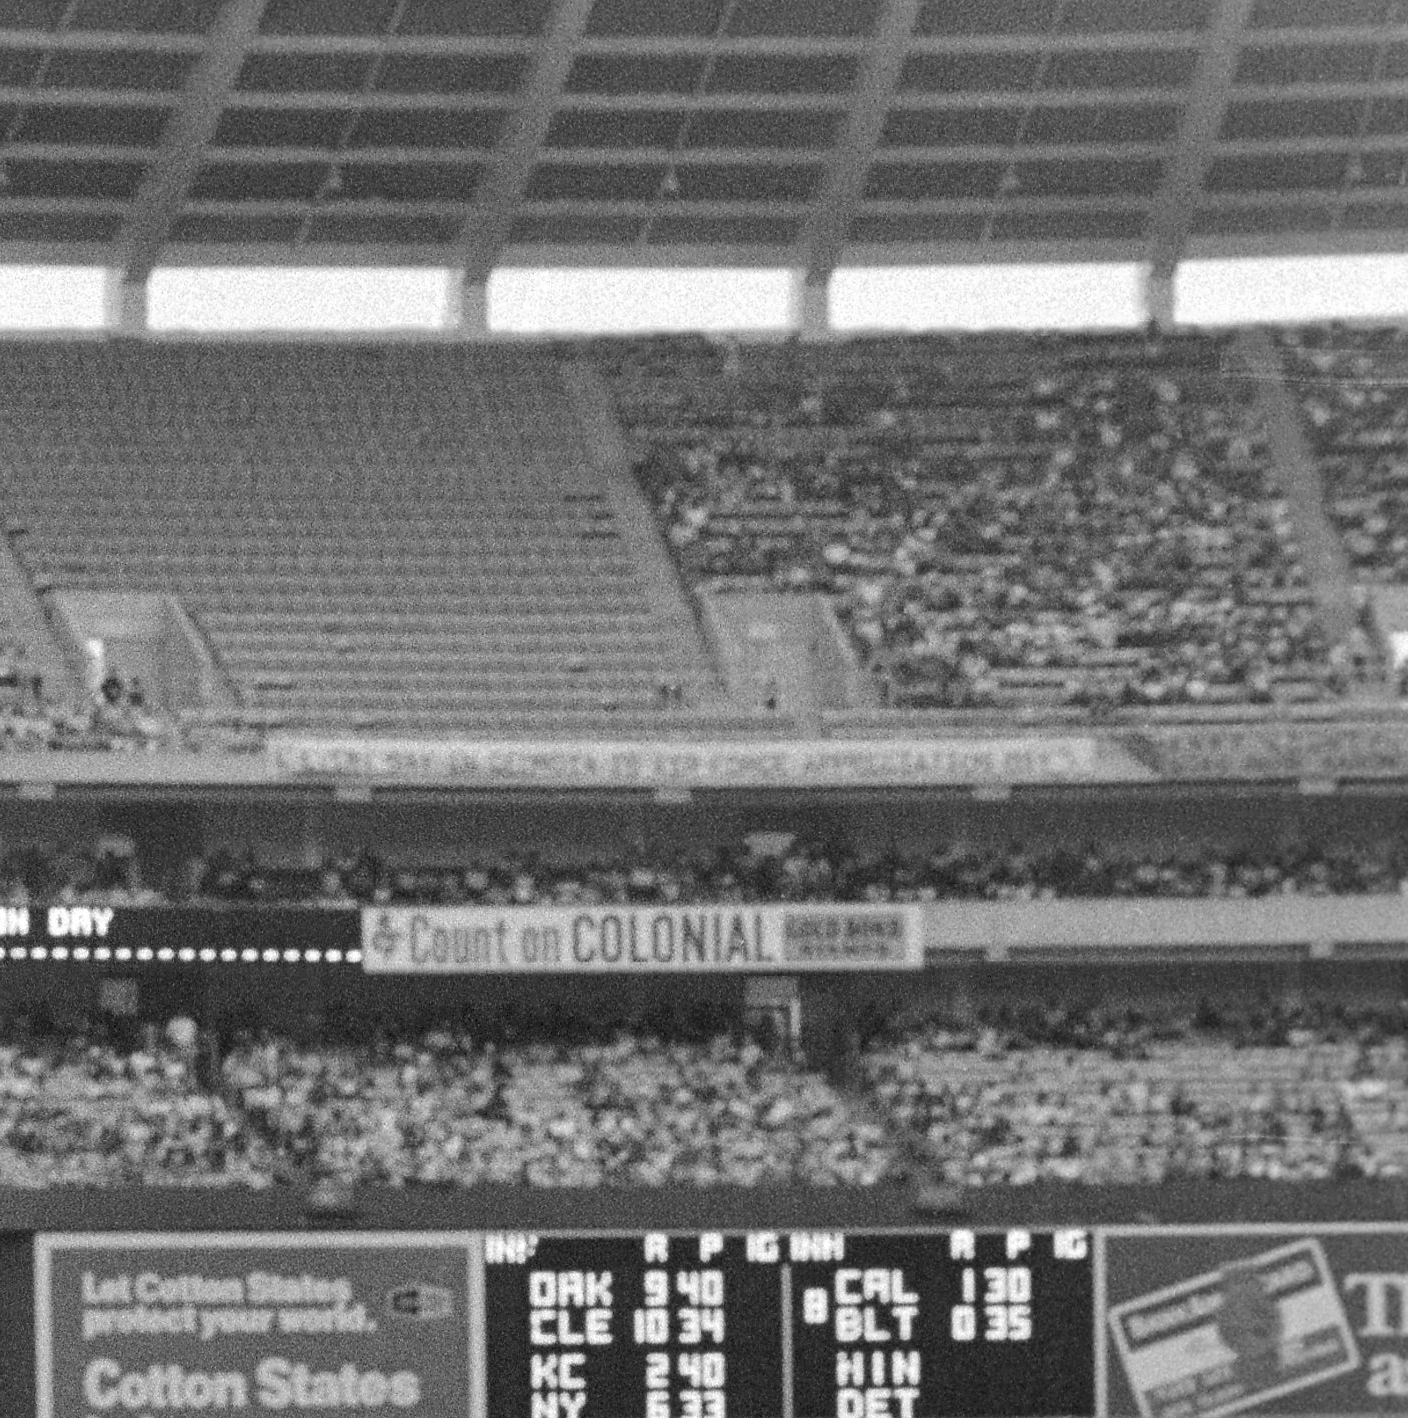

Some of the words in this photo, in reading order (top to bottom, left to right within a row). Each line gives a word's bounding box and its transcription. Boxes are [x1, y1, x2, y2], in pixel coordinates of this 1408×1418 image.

[48, 906, 114, 937] DAY
[411, 910, 510, 965] Count
[522, 925, 562, 965] on
[572, 912, 774, 965] COLONIAL
[699, 1232, 724, 1263] P
[1005, 1228, 1031, 1260] P
[84, 1270, 130, 1302] Let
[134, 1272, 244, 1302] Cotton
[246, 1271, 353, 1302] States
[529, 1270, 613, 1307] OAK
[643, 1270, 669, 1307] 9
[676, 1270, 725, 1307] 40
[835, 1268, 920, 1305] CAL
[984, 1267, 1032, 1303] 30
[83, 1306, 196, 1339] protect
[199, 1308, 274, 1339] your
[1343, 1272, 1408, 1338] T
[529, 1308, 614, 1345] CLE
[634, 1308, 670, 1344] 10
[678, 1308, 726, 1344] 34
[835, 1305, 920, 1343] BLT
[984, 1305, 1032, 1342] 35
[85, 1358, 248, 1408] Cotton
[255, 1357, 420, 1408] States
[530, 1352, 587, 1390] KC
[646, 1352, 670, 1389] 2
[678, 1352, 726, 1389] 40
